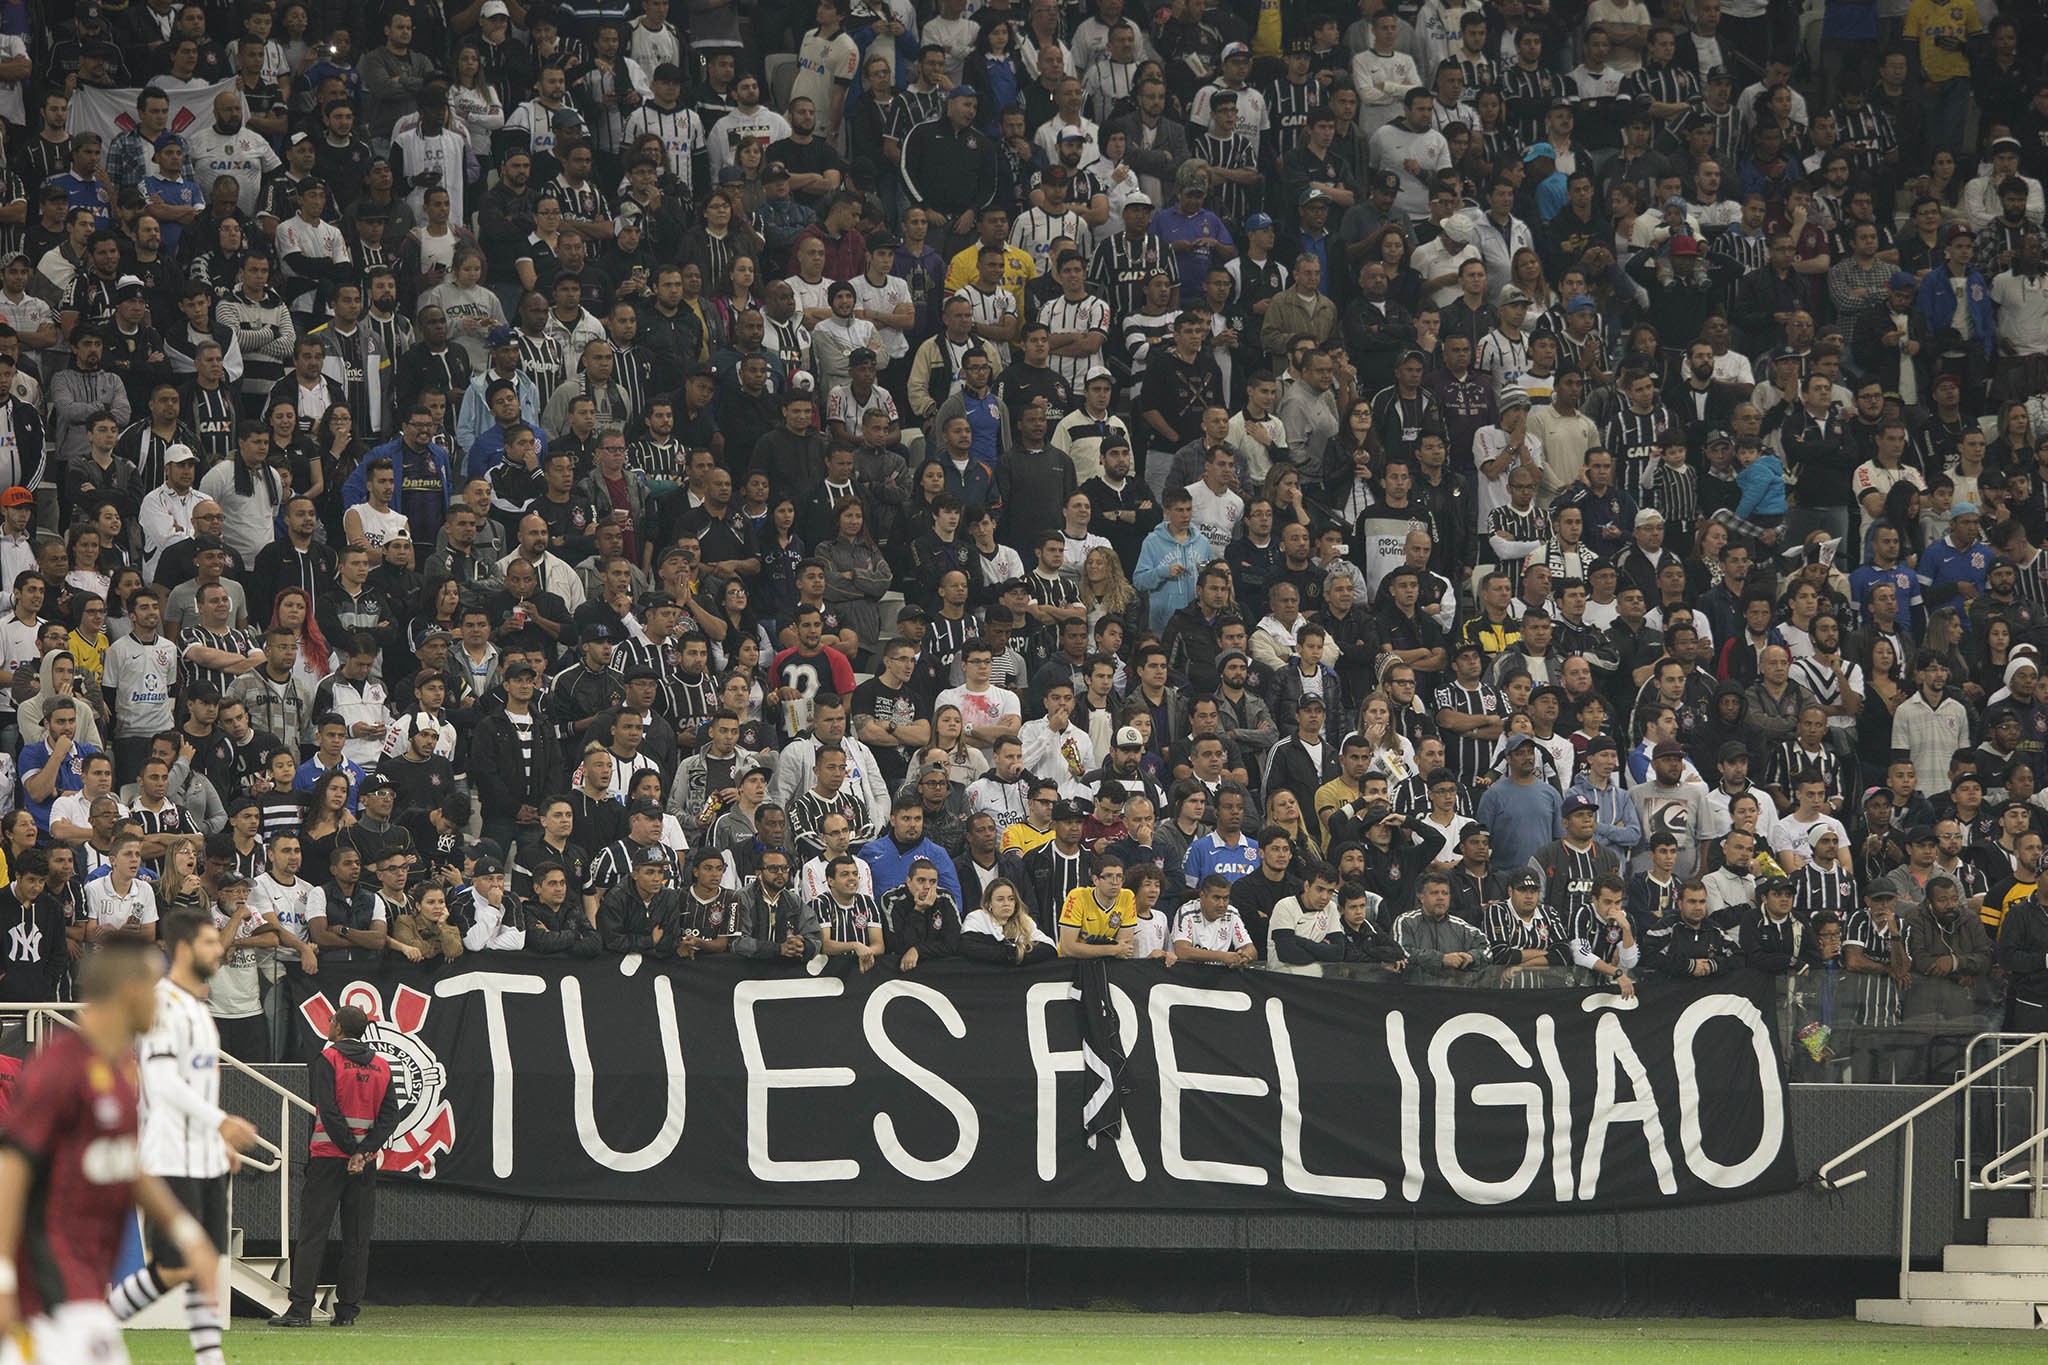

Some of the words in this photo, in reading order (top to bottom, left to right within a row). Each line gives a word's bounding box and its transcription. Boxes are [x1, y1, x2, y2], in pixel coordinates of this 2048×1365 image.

[209, 160, 252, 171] CAIXA
[199, 420, 232, 433] CAIX
[1858, 467, 1871, 487] FISK
[1378, 538, 1399, 547] neo
[384, 726, 402, 755] FISK
[790, 808, 803, 832] FISK
[996, 810, 1019, 821] neo
[1214, 863, 1255, 875] CAIXA
[807, 867, 818, 898] bozzano
[100, 898, 114, 916] 10
[728, 901, 738, 933] bozzano
[1064, 895, 1077, 920] FISK
[7, 921, 43, 964] NY
[434, 954, 687, 1180] TÚ
[733, 954, 981, 1183] ÉS
[1025, 982, 1786, 1205] RELIGIÃO
